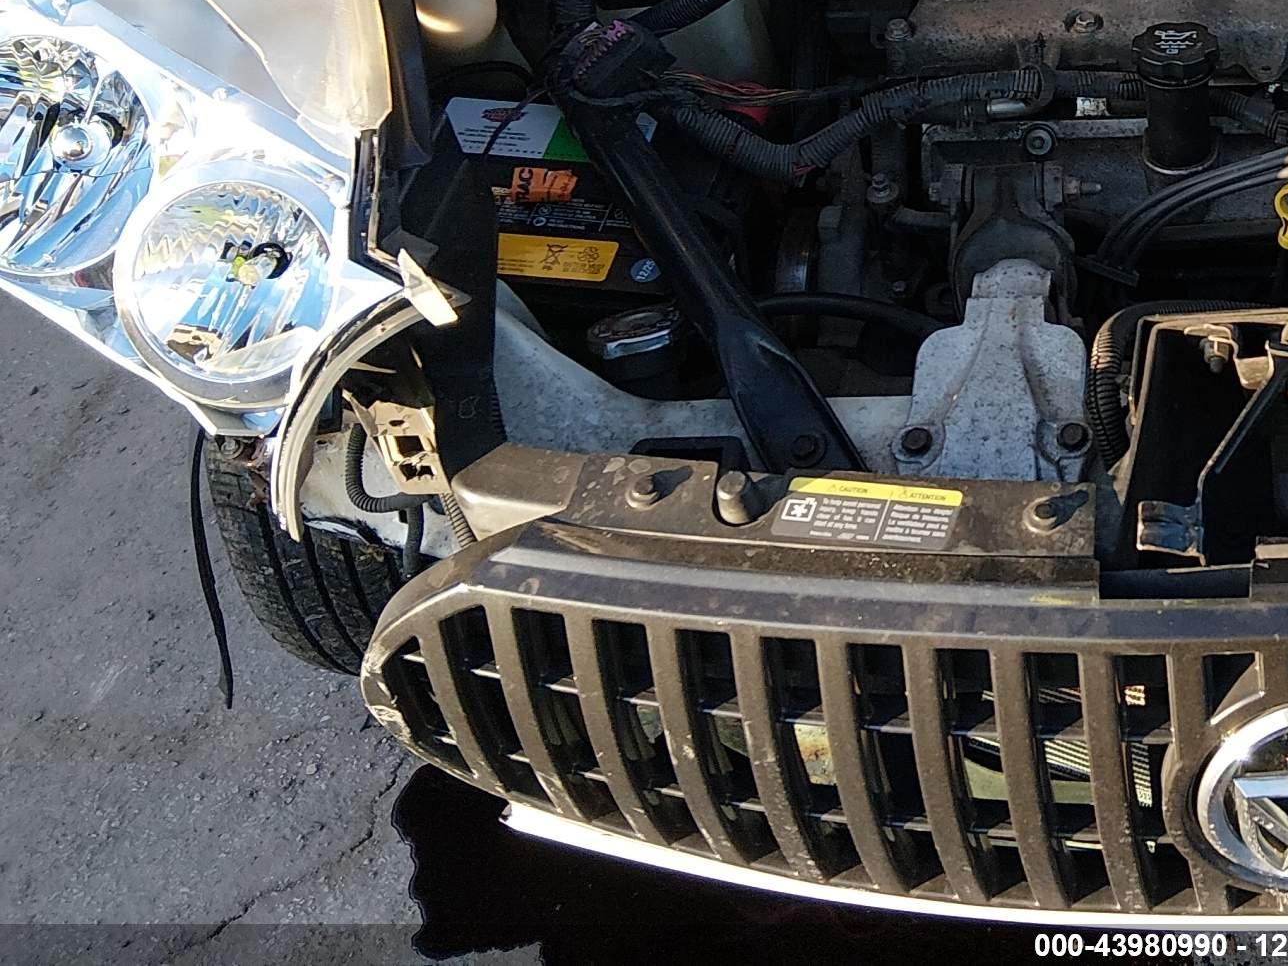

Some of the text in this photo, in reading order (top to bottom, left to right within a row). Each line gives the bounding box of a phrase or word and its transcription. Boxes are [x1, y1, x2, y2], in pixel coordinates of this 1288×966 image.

[635, 259, 656, 281] 12/25
[838, 486, 868, 494] CAUTION
[910, 492, 947, 501] ATTENTION
